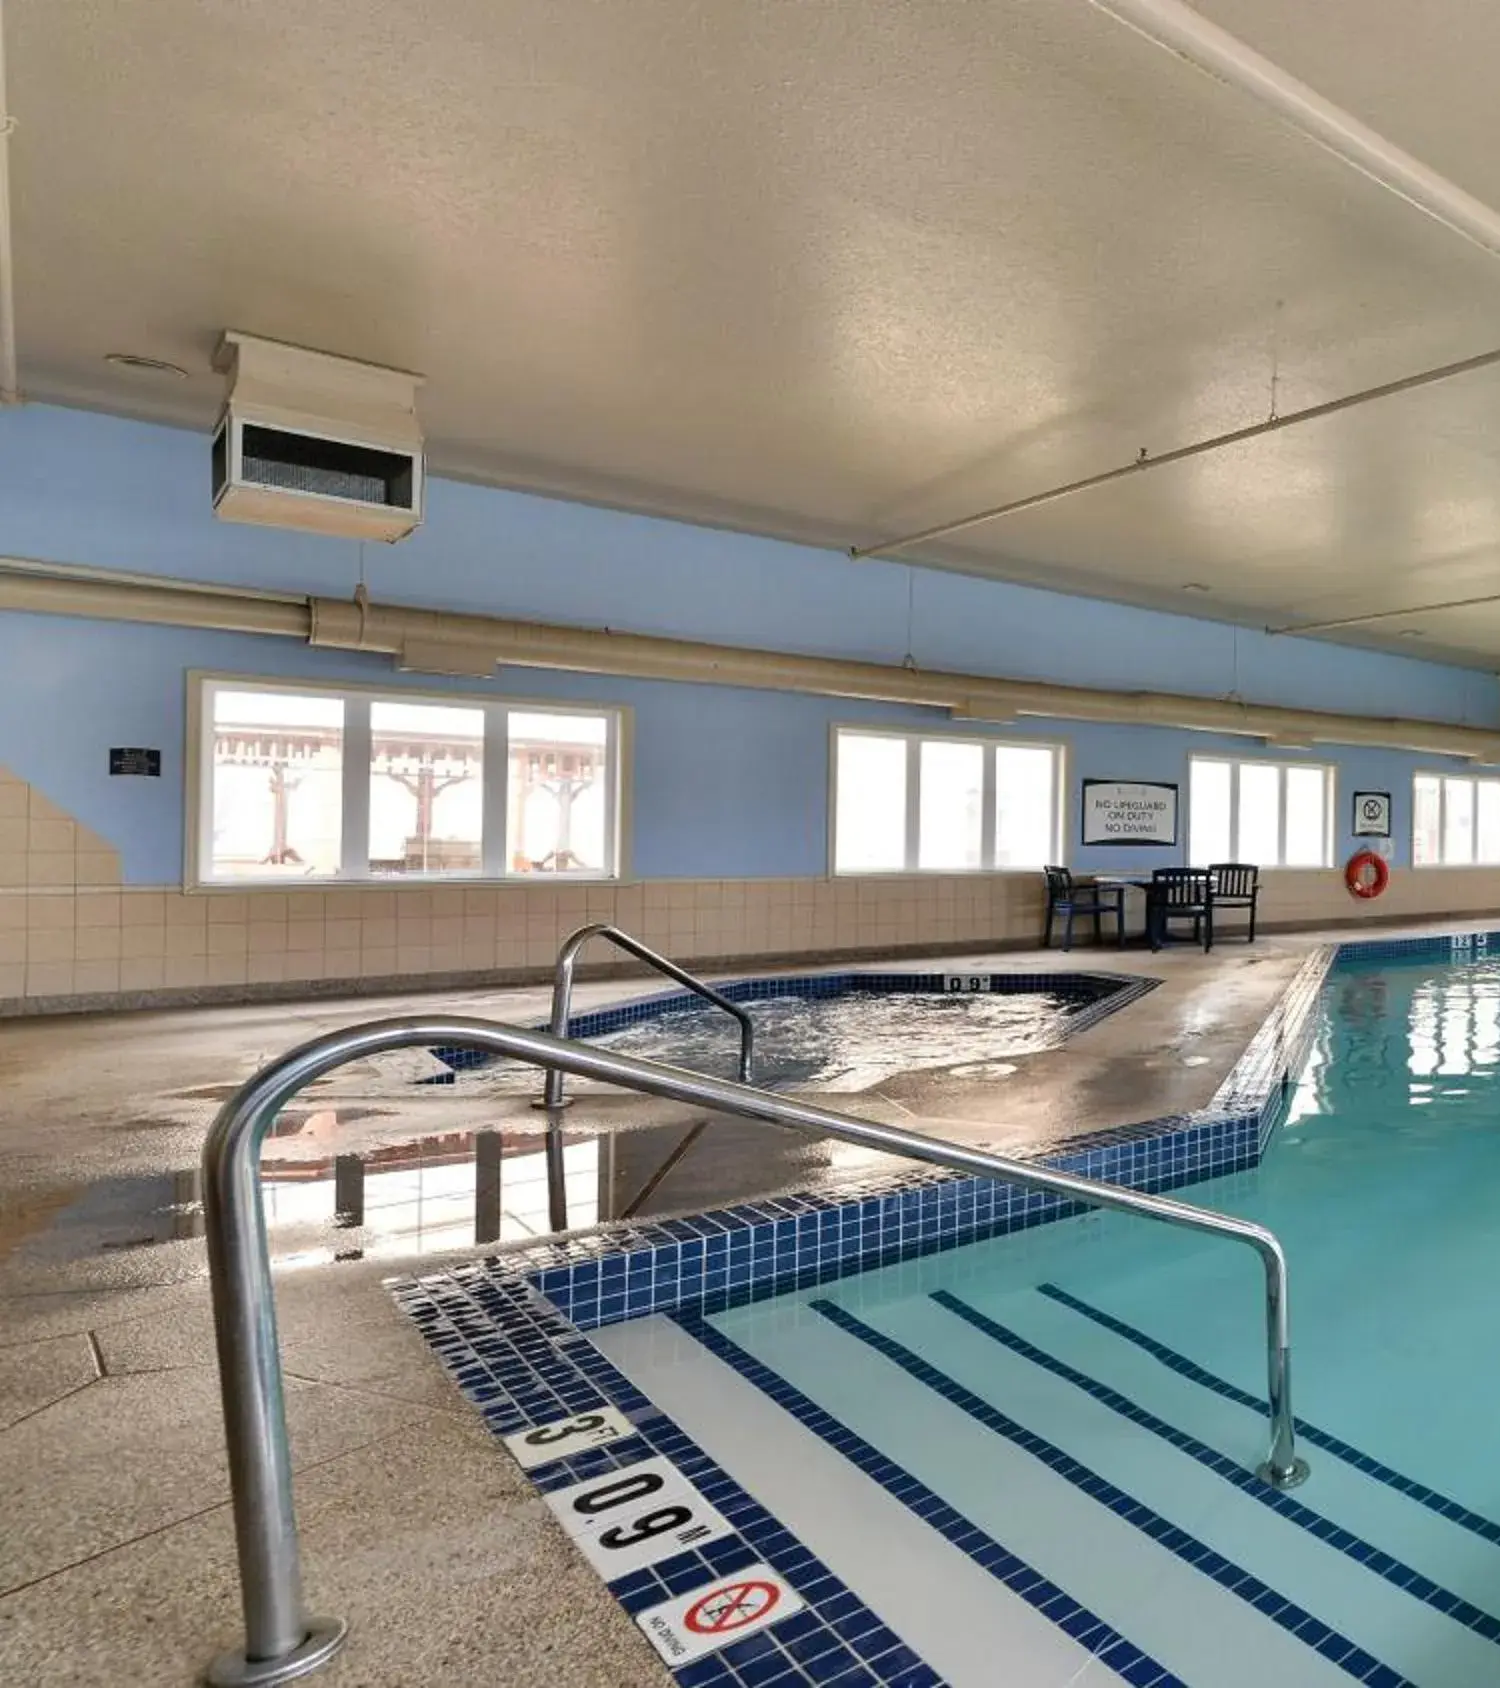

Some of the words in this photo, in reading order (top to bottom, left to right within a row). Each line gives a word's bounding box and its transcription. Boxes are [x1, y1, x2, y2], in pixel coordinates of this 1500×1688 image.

[1095, 800, 1111, 809] NO
[1113, 800, 1167, 810] LIFEGUARD
[1107, 811, 1124, 820] ON
[1127, 811, 1153, 820] DUTY
[1106, 823, 1120, 832] NO
[525, 1415, 605, 1445] 3
[650, 1616, 666, 1629] NO
